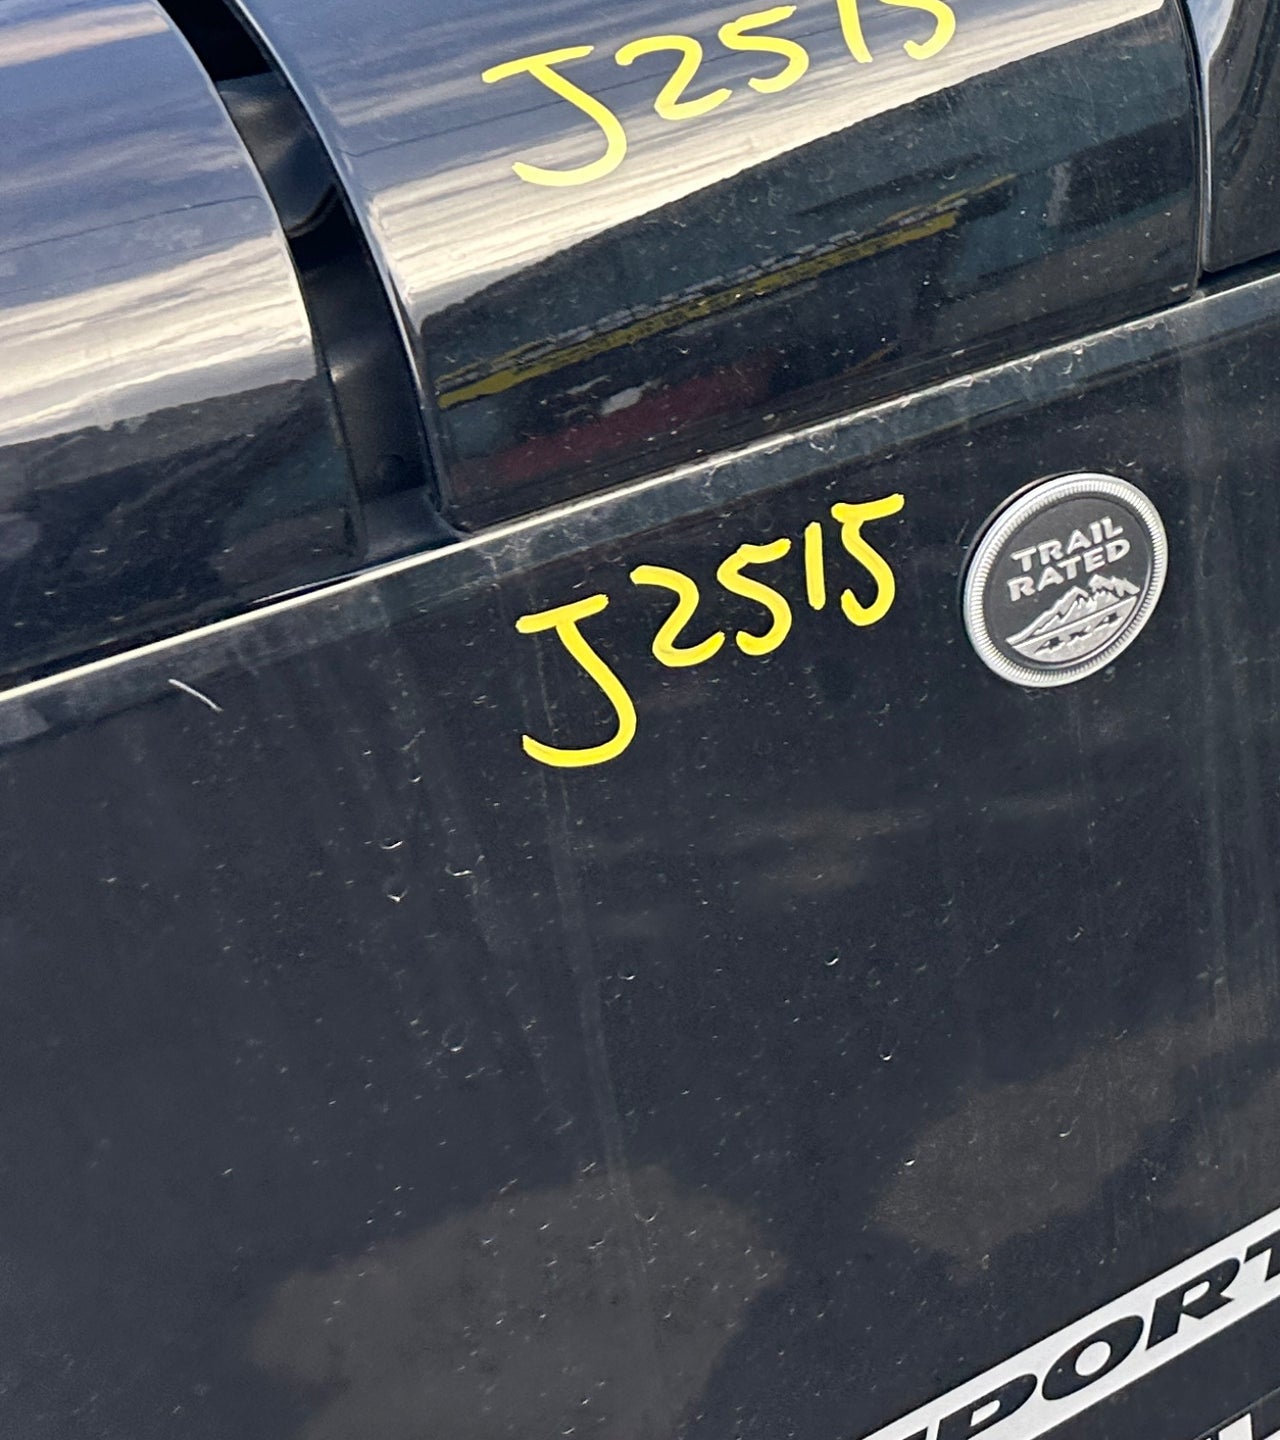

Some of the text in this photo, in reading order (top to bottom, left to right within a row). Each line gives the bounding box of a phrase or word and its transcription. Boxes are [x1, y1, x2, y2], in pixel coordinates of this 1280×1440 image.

[1007, 538, 1131, 602] RATED
[1010, 516, 1125, 573] TRAIL
[515, 493, 905, 768] J2515
